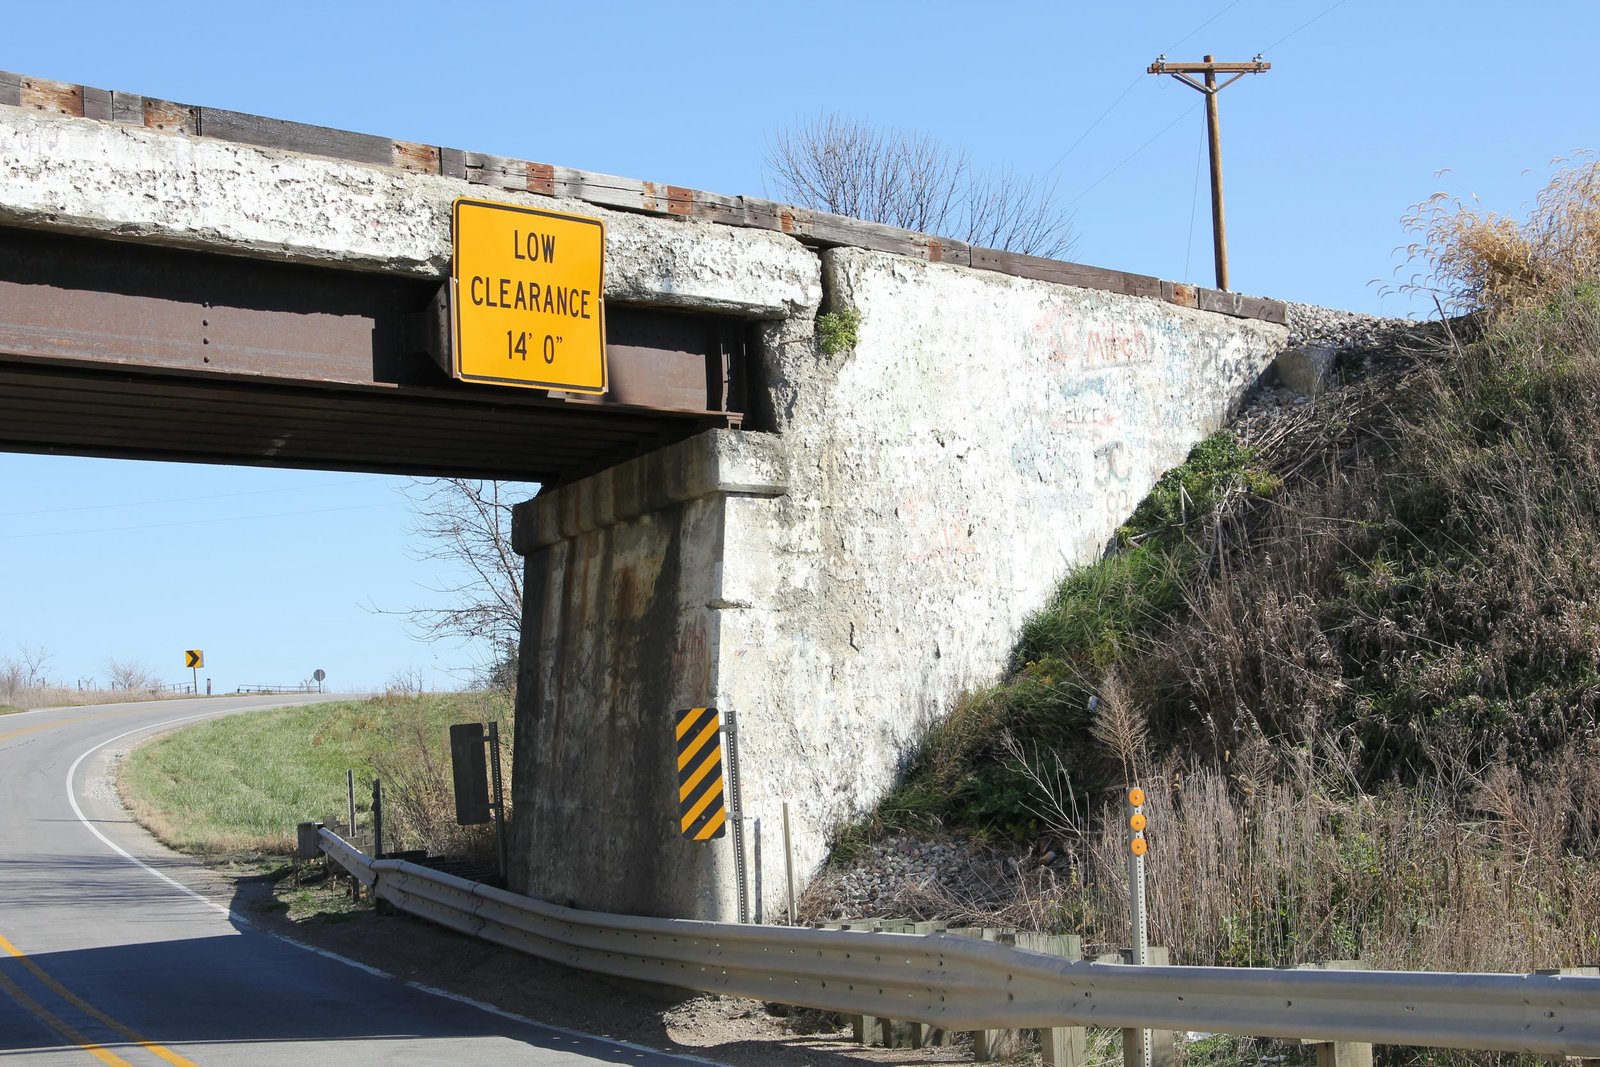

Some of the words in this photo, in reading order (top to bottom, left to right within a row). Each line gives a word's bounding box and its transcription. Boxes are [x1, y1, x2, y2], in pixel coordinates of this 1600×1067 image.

[514, 229, 556, 264] LOW
[471, 275, 591, 320] CLEARANCE
[507, 330, 533, 361] 14'
[543, 334, 563, 365] 0"
